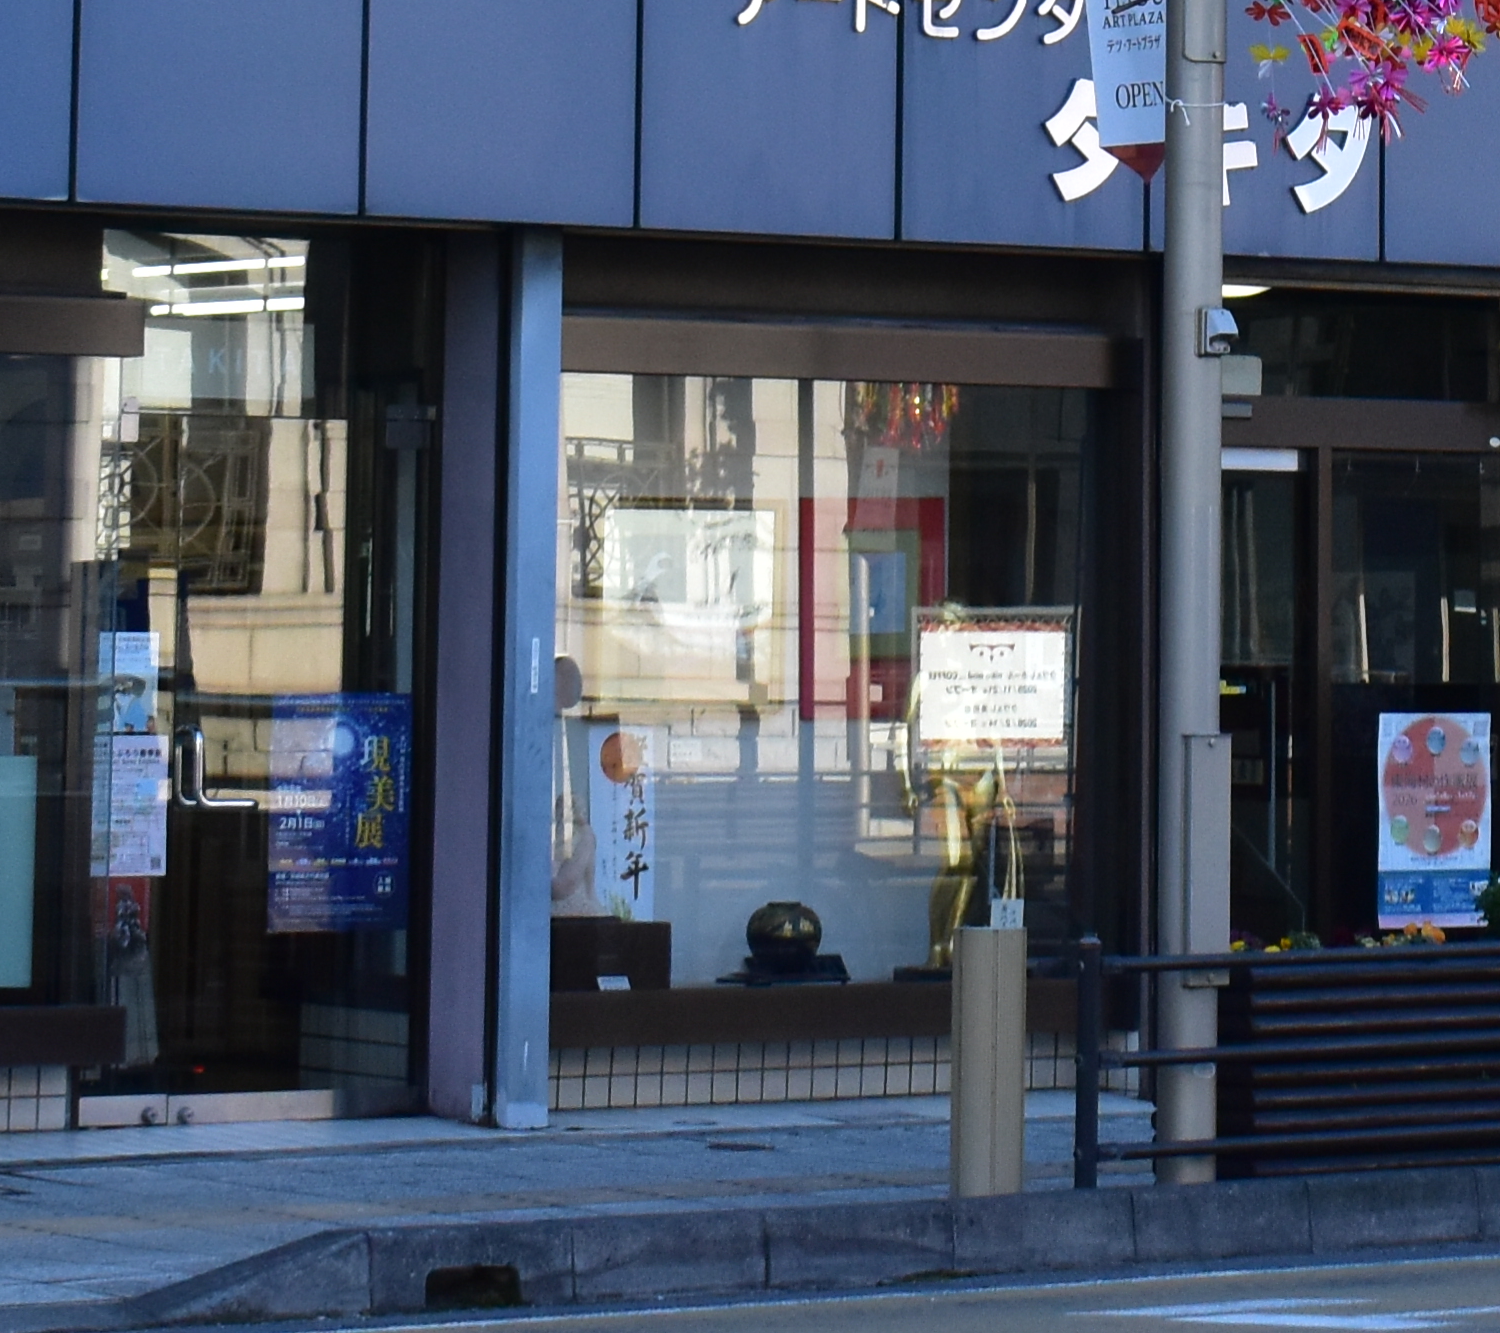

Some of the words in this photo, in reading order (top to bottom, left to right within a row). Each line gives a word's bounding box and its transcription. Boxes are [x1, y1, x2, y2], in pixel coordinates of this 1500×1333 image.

[1102, 14, 1126, 30] ART
[1128, 10, 1165, 26] PLAZA
[1106, 34, 1162, 54] テツ・アートプラザ
[1115, 80, 1164, 110] OPEN
[354, 735, 395, 849] 現美展
